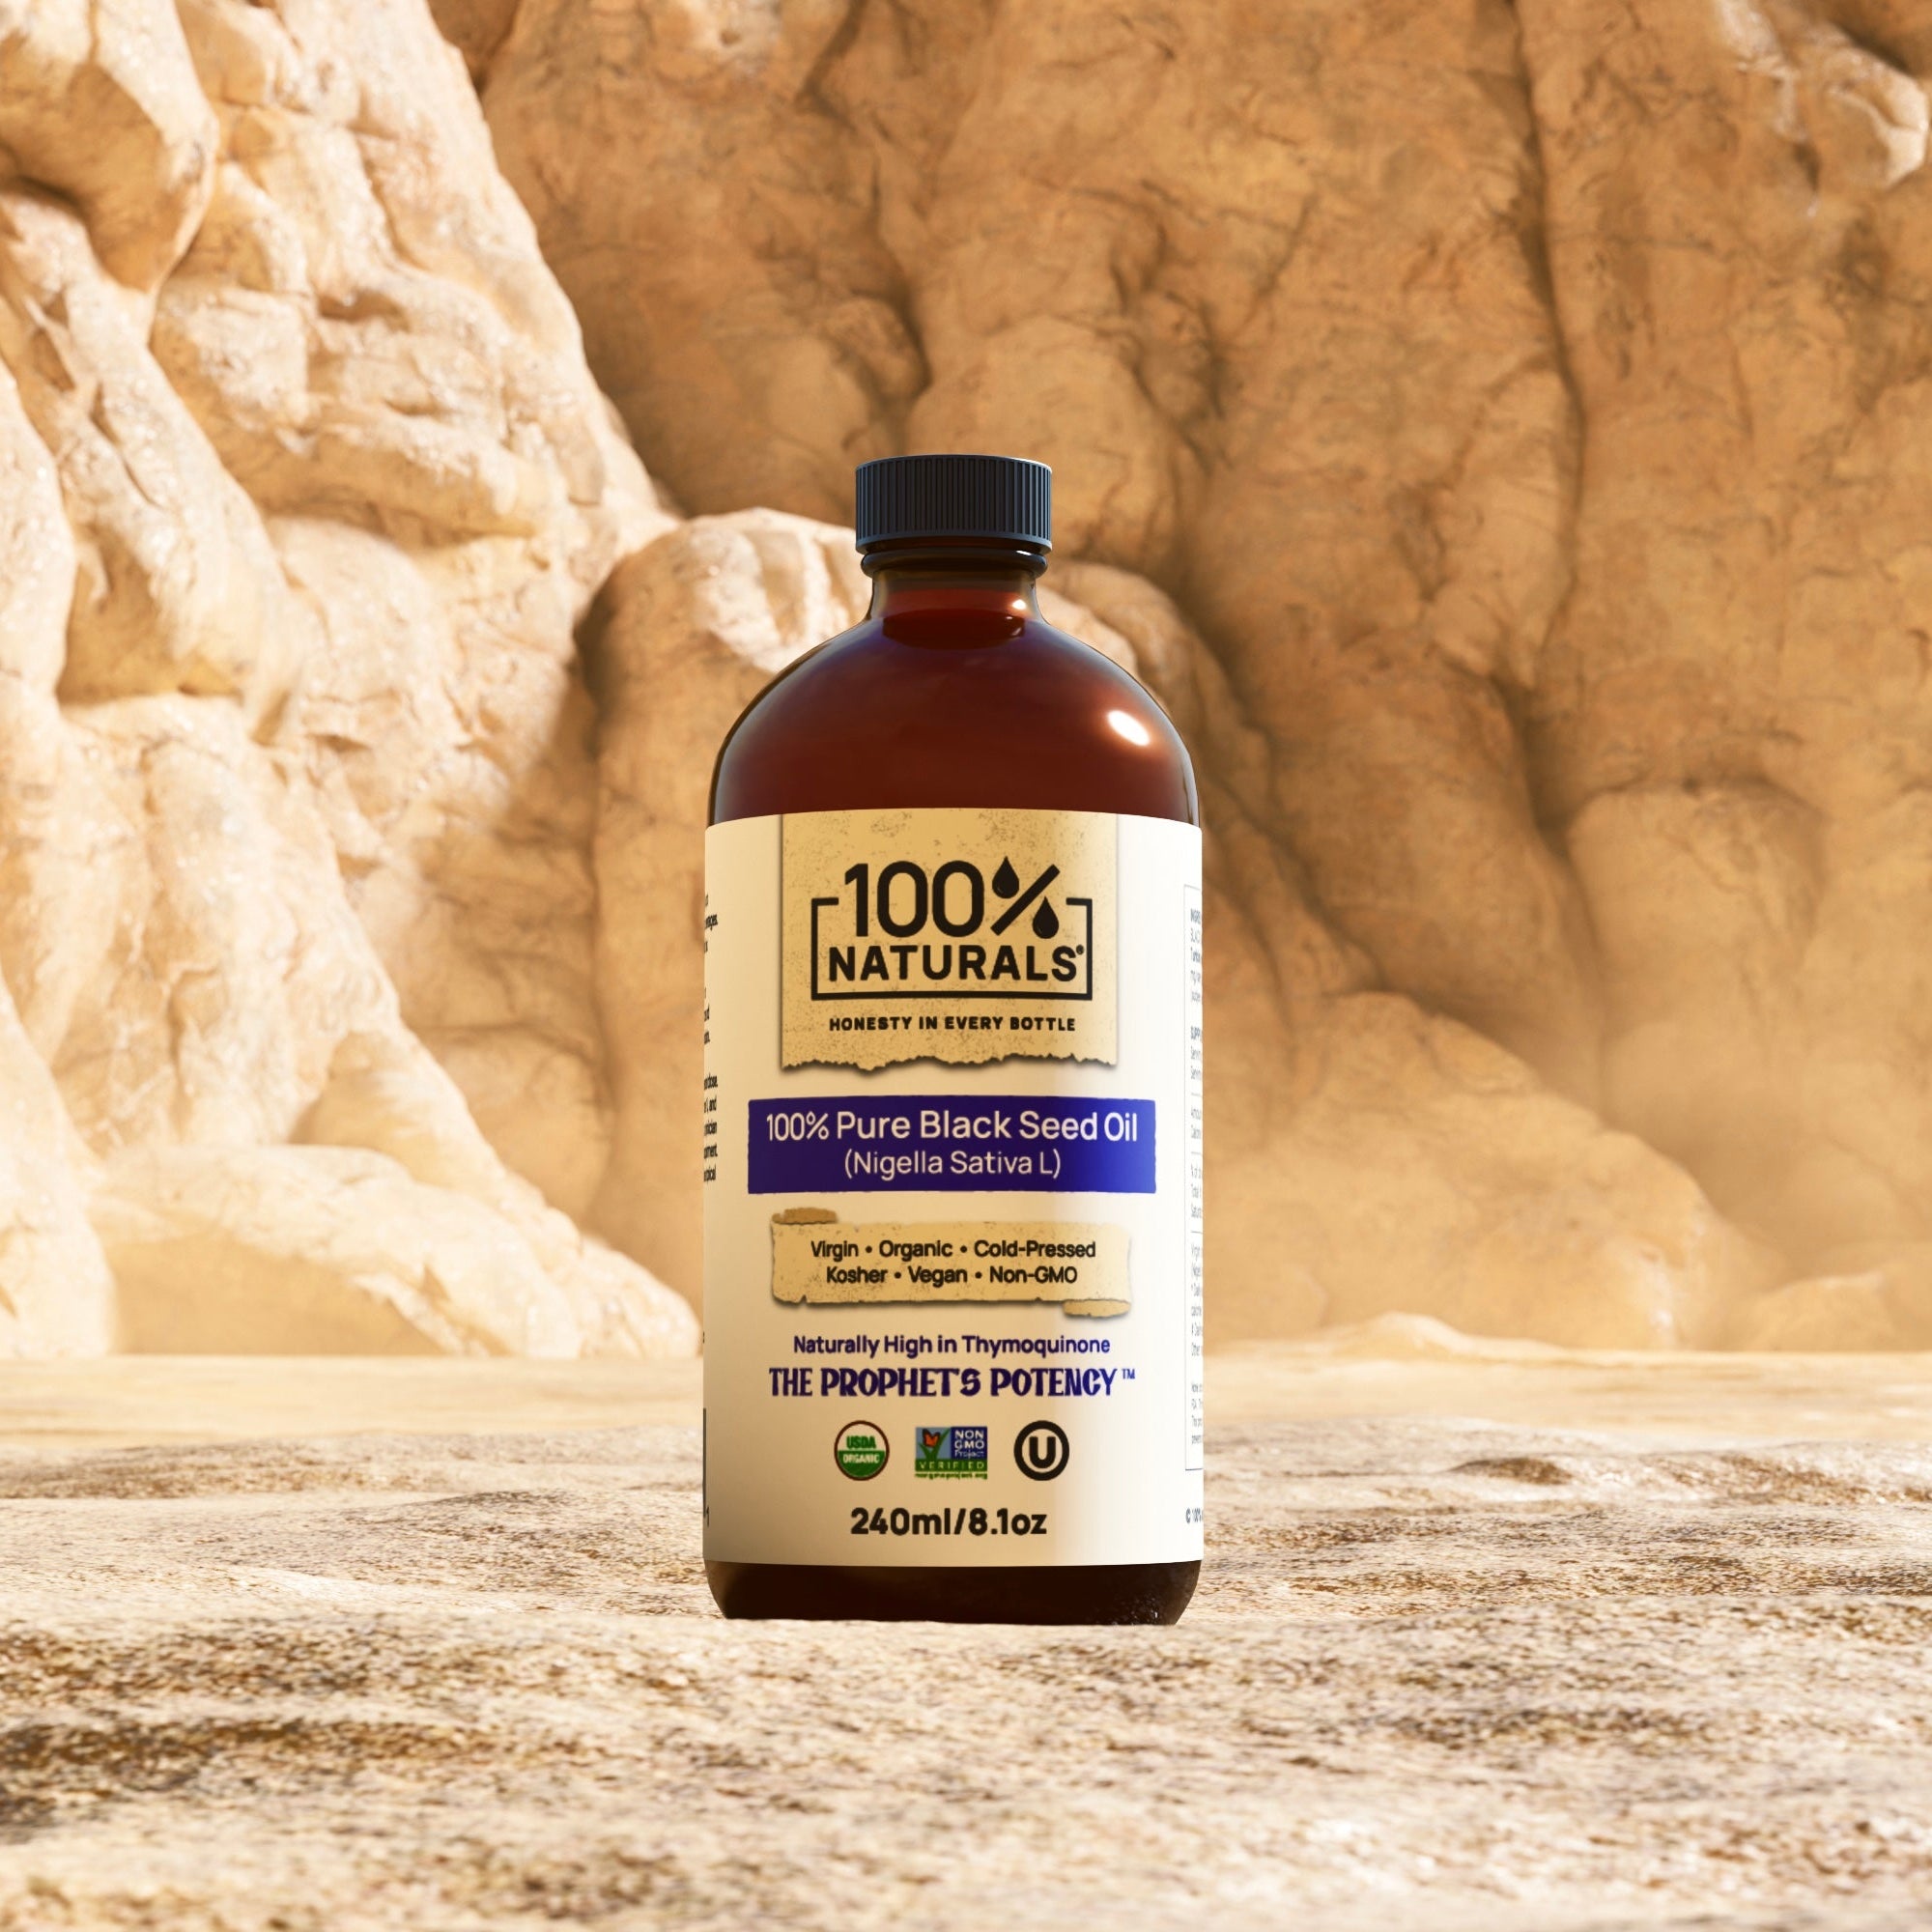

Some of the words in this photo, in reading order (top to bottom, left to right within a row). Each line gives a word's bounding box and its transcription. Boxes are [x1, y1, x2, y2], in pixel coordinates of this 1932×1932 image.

[845, 857, 1061, 940] 100%
[830, 1017, 912, 1033] HONESTY
[919, 1017, 938, 1031] IN
[945, 1016, 1004, 1032] EVERY
[1010, 1017, 1076, 1033] BOTTLE
[767, 1112, 830, 1143] 100%
[838, 1111, 911, 1140] Pure
[922, 1110, 1012, 1140] Black
[1020, 1111, 1097, 1141] Seed
[1104, 1112, 1138, 1143] Oil
[845, 1150, 943, 1182] (Nigella
[951, 1151, 1031, 1176] Sativa
[1040, 1150, 1062, 1181] L)
[811, 1239, 859, 1264] Virgin
[879, 1240, 953, 1264] Organic
[974, 1240, 1096, 1260] Cold-Pressed
[827, 1266, 887, 1286] Kosher
[908, 1267, 968, 1290] Vegan
[990, 1266, 1078, 1286] Non-GMO
[794, 1335, 880, 1358] Naturally
[884, 1335, 932, 1359] High
[937, 1335, 957, 1353] in
[962, 1335, 1111, 1358] Thymoquinone
[769, 1368, 812, 1397] THE
[846, 1435, 877, 1449] USDA
[954, 1430, 984, 1439] NON
[954, 1439, 985, 1450] GMO
[842, 1454, 880, 1464] ORGANIC
[919, 1461, 985, 1470] VERIFIED
[954, 1449, 984, 1459] Project
[851, 1508, 1048, 1537] 240ml/8.1oz
